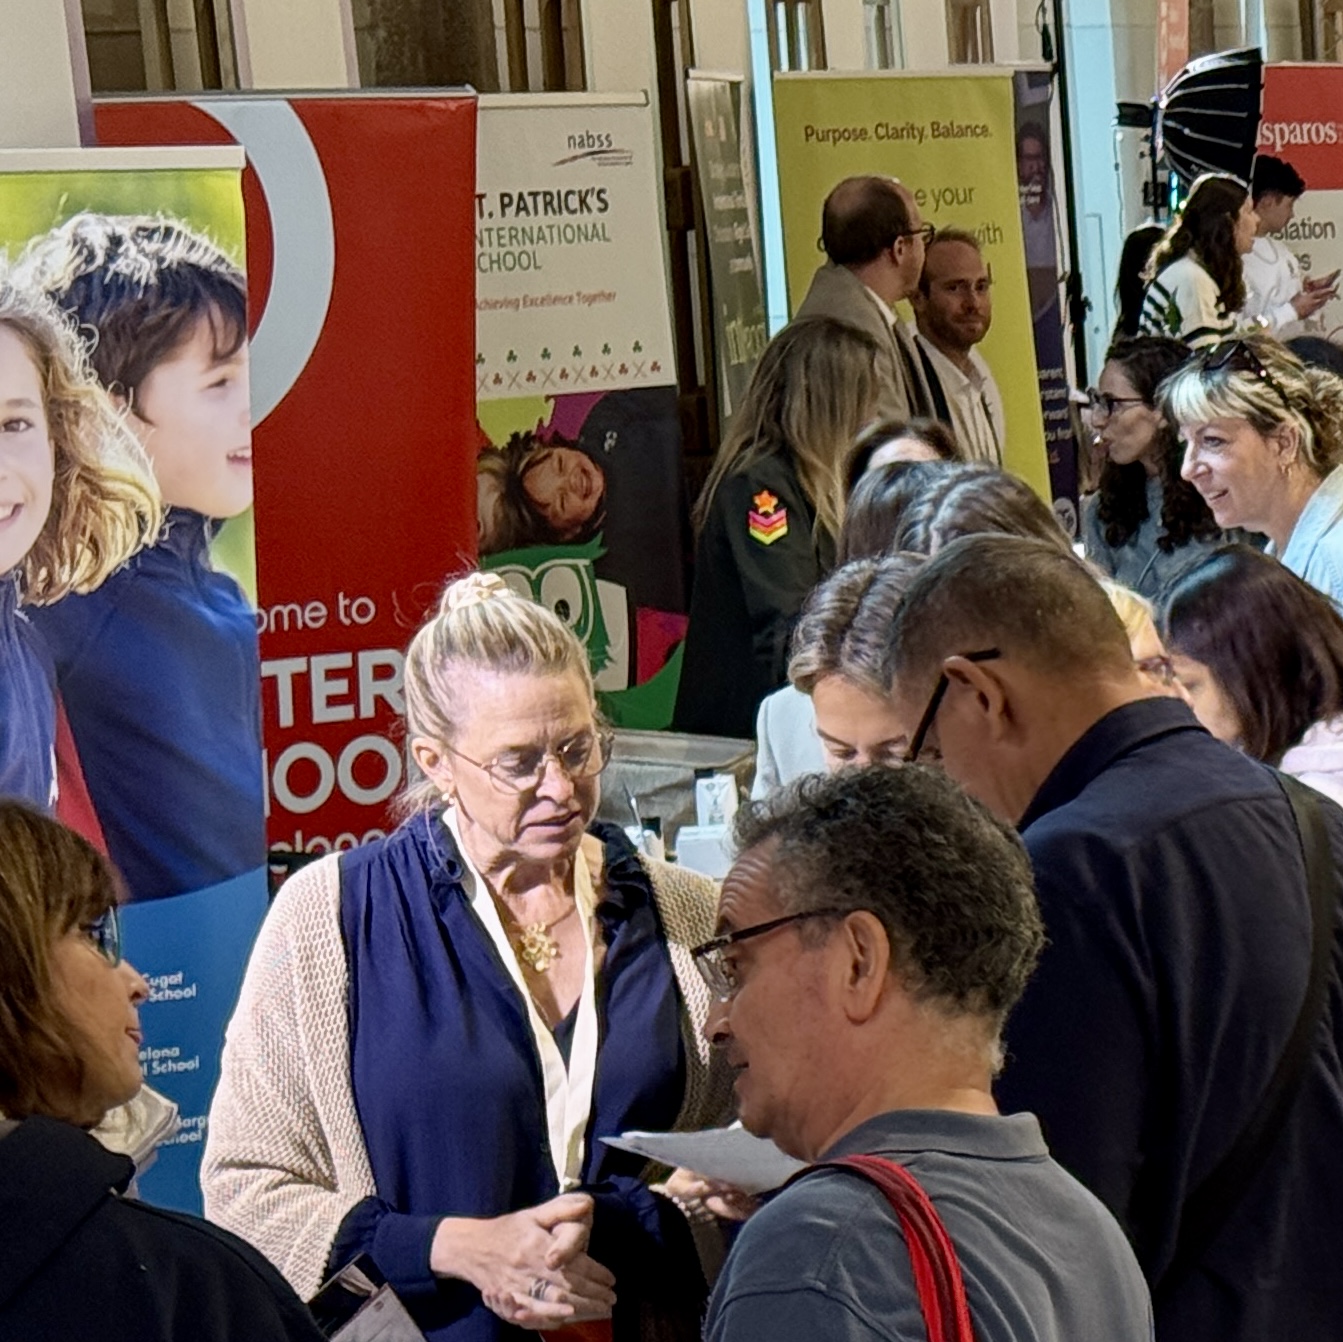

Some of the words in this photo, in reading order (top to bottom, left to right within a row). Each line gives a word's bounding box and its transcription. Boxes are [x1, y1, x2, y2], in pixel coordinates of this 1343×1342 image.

[567, 130, 613, 149] nabss
[804, 124, 872, 146] Purpose.
[874, 121, 928, 144] Clarity.
[931, 120, 993, 139] Balance.
[500, 187, 609, 219] PATRICK'S
[931, 187, 975, 212] your
[338, 588, 376, 626] to
[262, 734, 403, 818] OO
[152, 1055, 200, 1076] School
